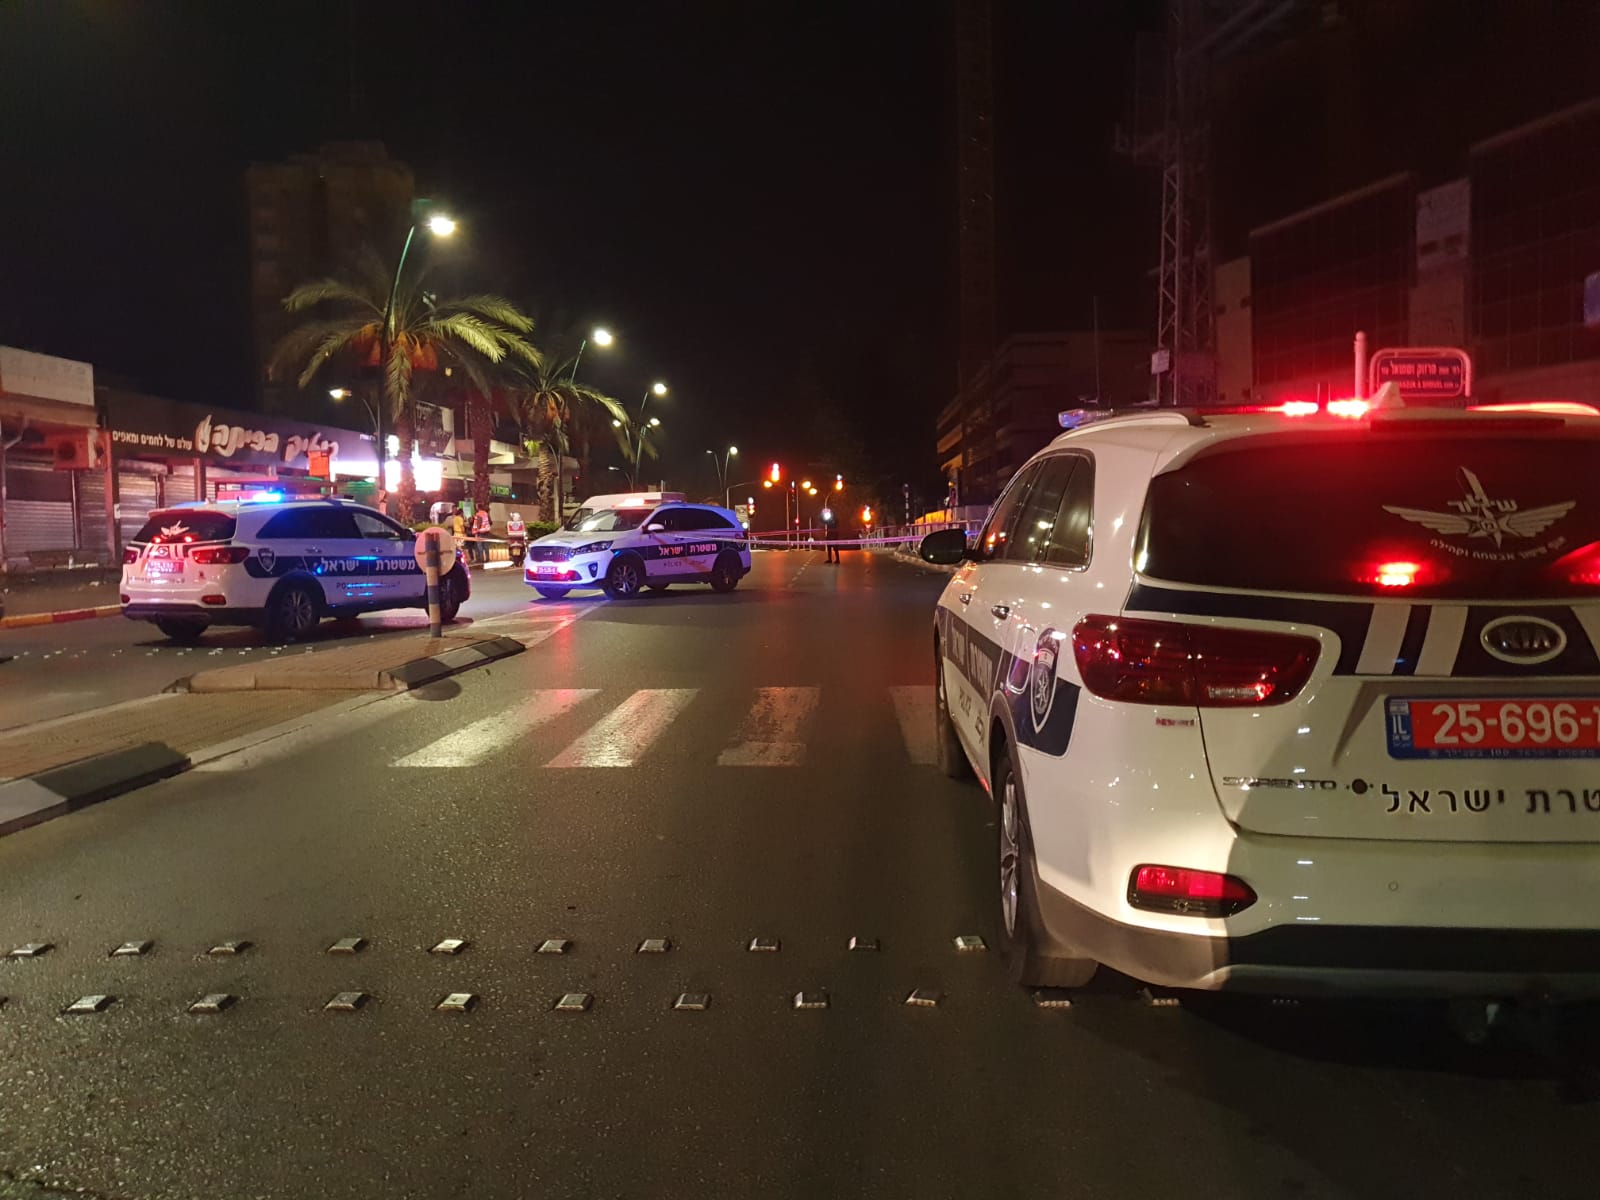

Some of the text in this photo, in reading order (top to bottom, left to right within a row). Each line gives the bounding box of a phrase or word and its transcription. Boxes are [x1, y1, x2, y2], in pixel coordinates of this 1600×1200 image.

[112, 430, 193, 451] עולם של לחמים ומאפים
[658, 544, 718, 556] משטרת ישראל
[1429, 538, 1469, 557] וקהילה
[320, 556, 416, 572] משטרת ישראל
[1382, 783, 1505, 813] ישראל
